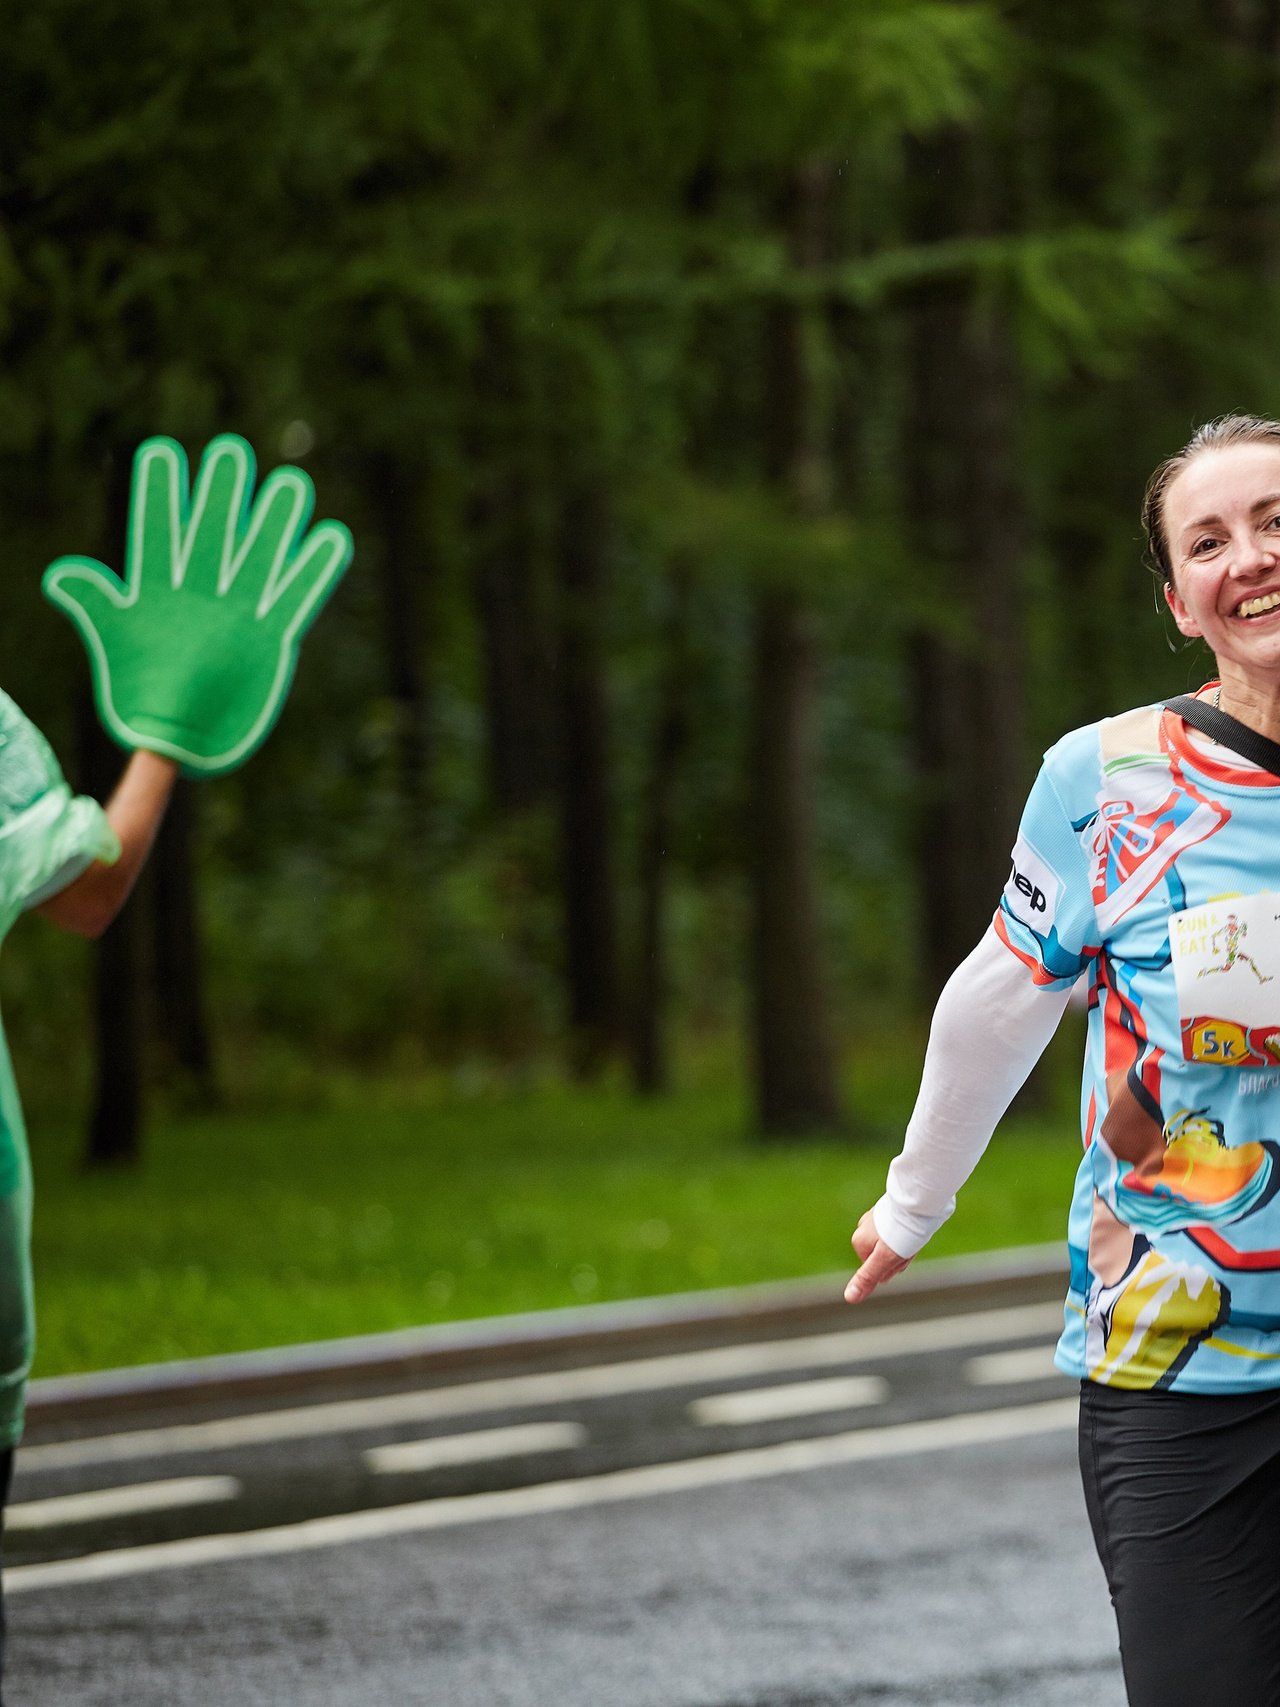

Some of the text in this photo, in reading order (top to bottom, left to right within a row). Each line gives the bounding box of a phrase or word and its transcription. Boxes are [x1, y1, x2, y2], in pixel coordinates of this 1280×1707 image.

[1013, 862, 1047, 913] ер
[1177, 914, 1207, 934] RUN
[1179, 935, 1207, 956] EAT
